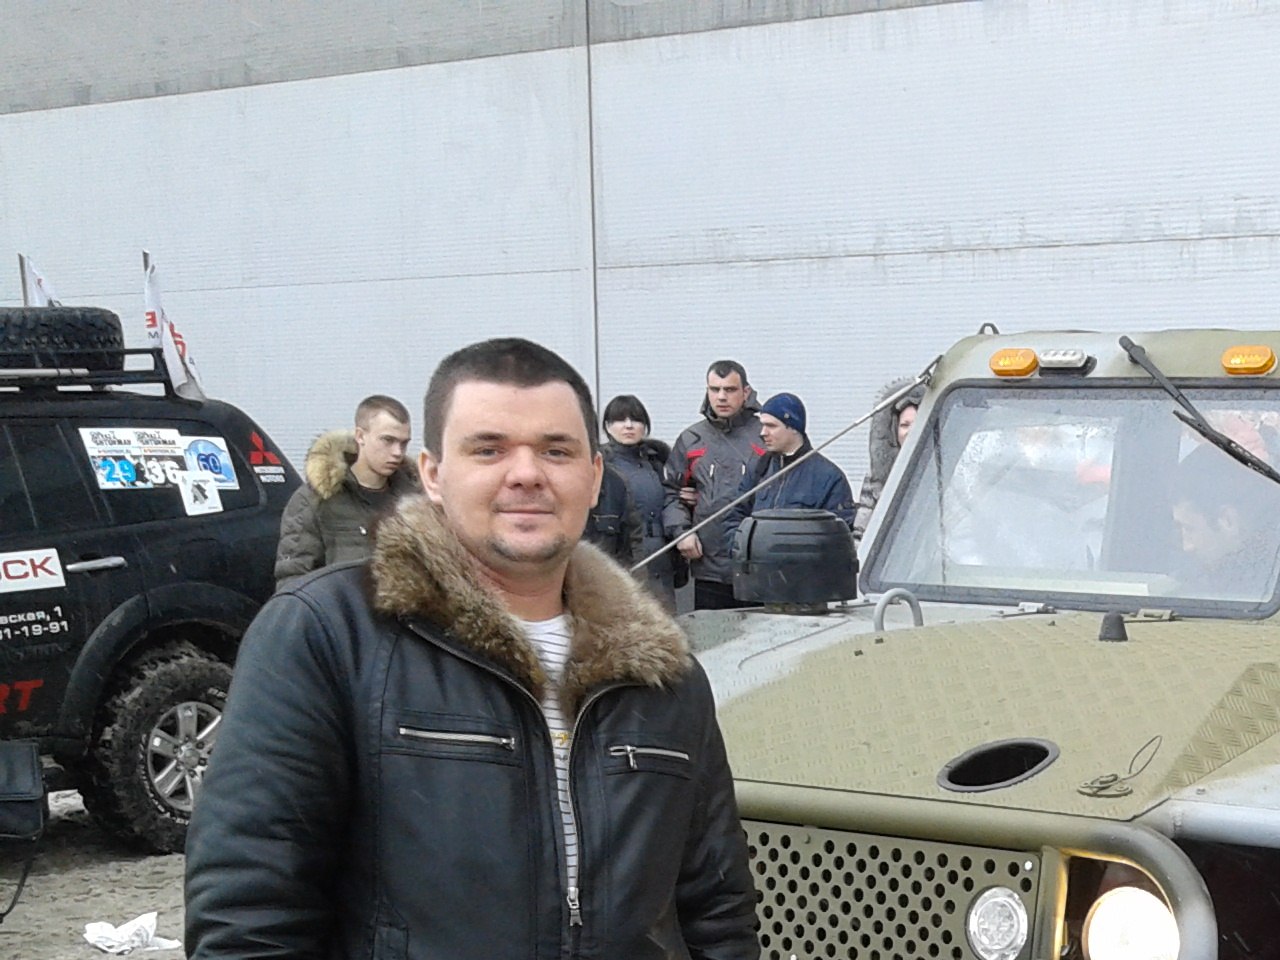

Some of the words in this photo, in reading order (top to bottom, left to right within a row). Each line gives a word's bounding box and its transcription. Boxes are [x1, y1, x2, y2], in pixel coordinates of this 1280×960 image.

[100, 458, 136, 482] 29
[145, 460, 181, 485] 36
[197, 453, 222, 474] 60
[54, 606, 63, 617] 1
[0, 620, 69, 640] 1-19-91
